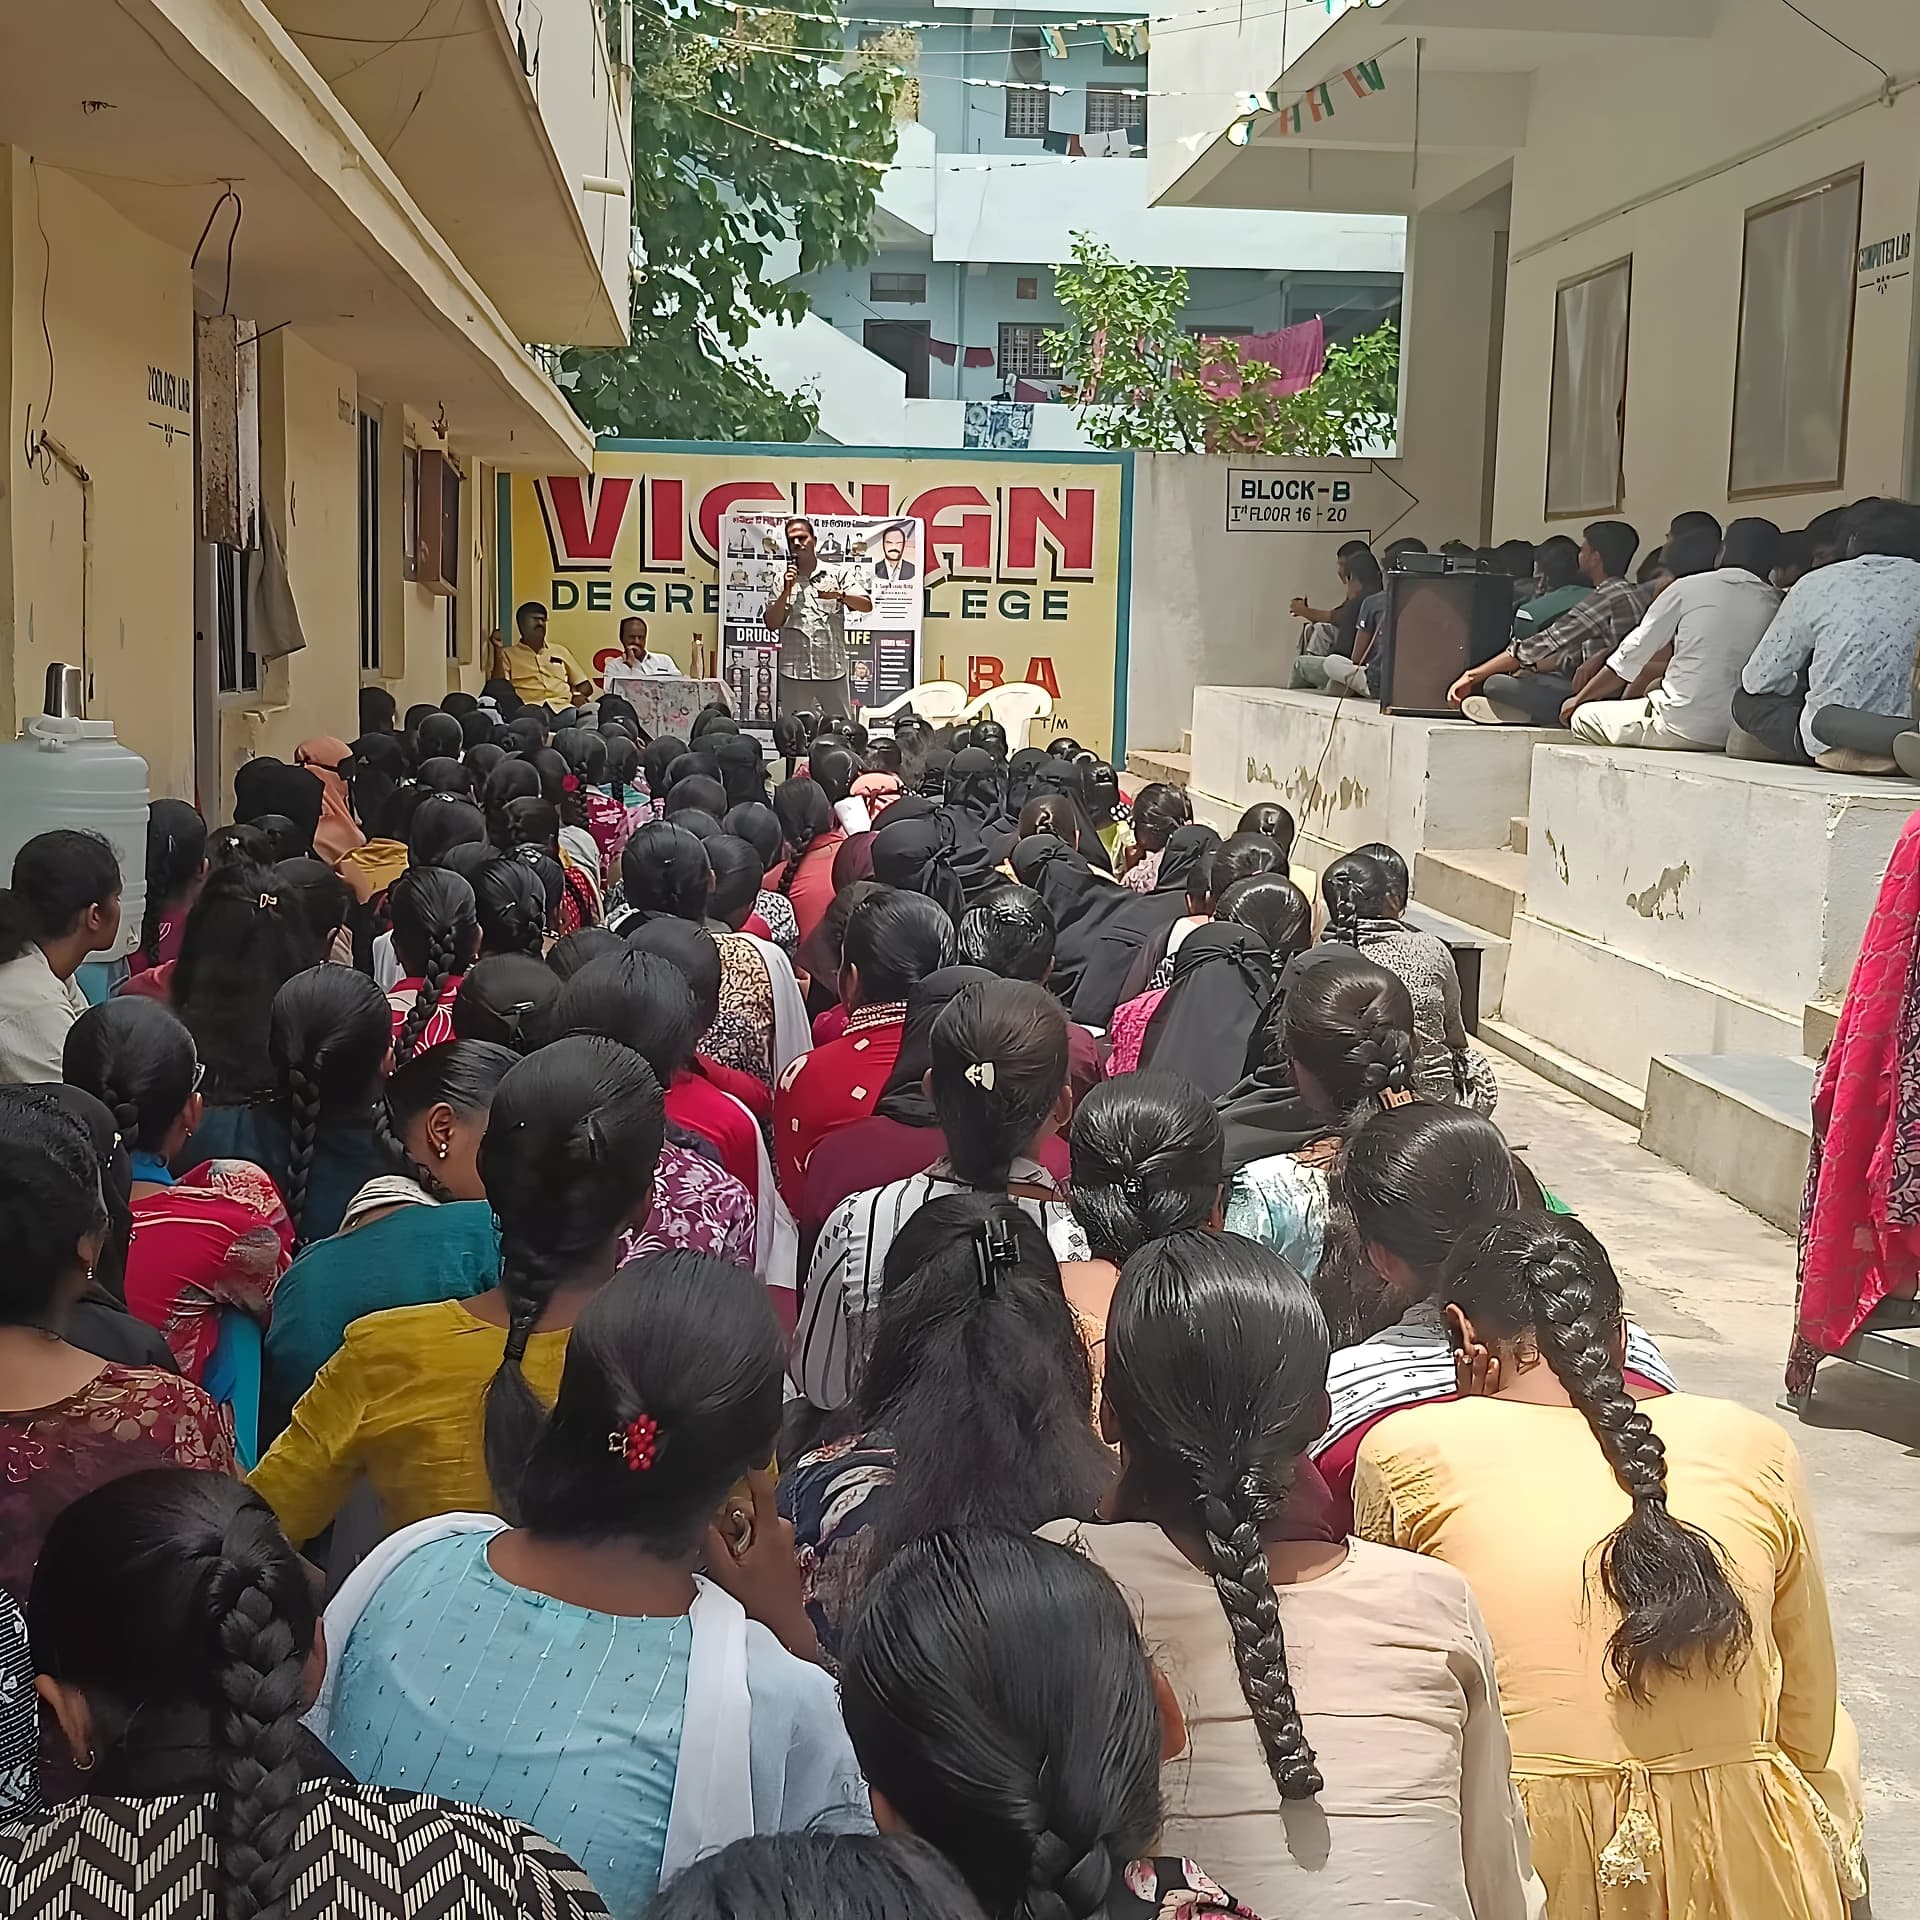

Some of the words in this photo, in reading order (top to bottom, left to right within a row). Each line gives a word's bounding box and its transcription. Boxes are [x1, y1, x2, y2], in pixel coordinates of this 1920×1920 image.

[1896, 232, 1911, 260] LAB
[147, 364, 176, 409] ZOOLOGY
[178, 377, 190, 414] LAB
[1249, 506, 1291, 522] FLOOR
[1295, 507, 1312, 522] 16
[1327, 507, 1347, 522] 20
[551, 579, 719, 614] DEGRE
[736, 627, 780, 643] DRUGS
